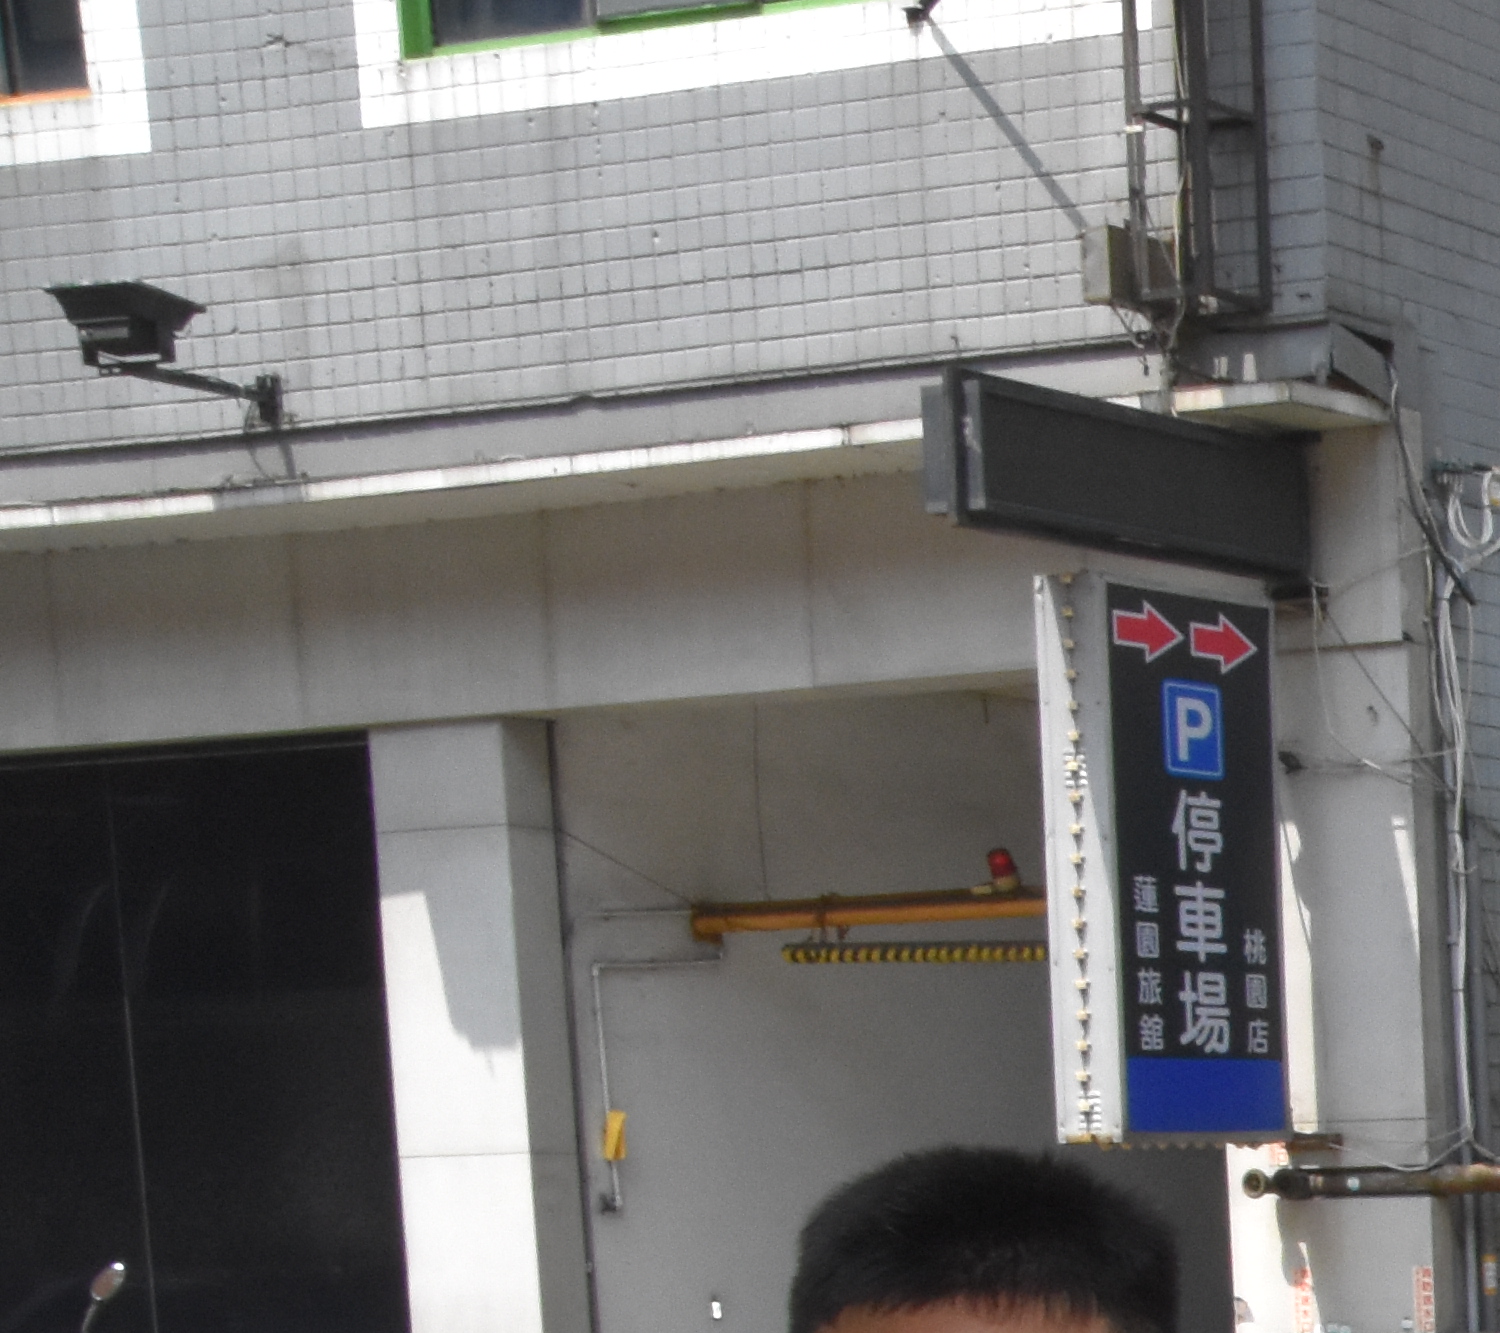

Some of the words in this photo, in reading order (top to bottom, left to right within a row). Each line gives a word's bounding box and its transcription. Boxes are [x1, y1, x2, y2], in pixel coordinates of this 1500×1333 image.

[1176, 696, 1213, 762] P
[1171, 789, 1230, 1054] 停車場
[1243, 927, 1269, 1054] 桃園店
